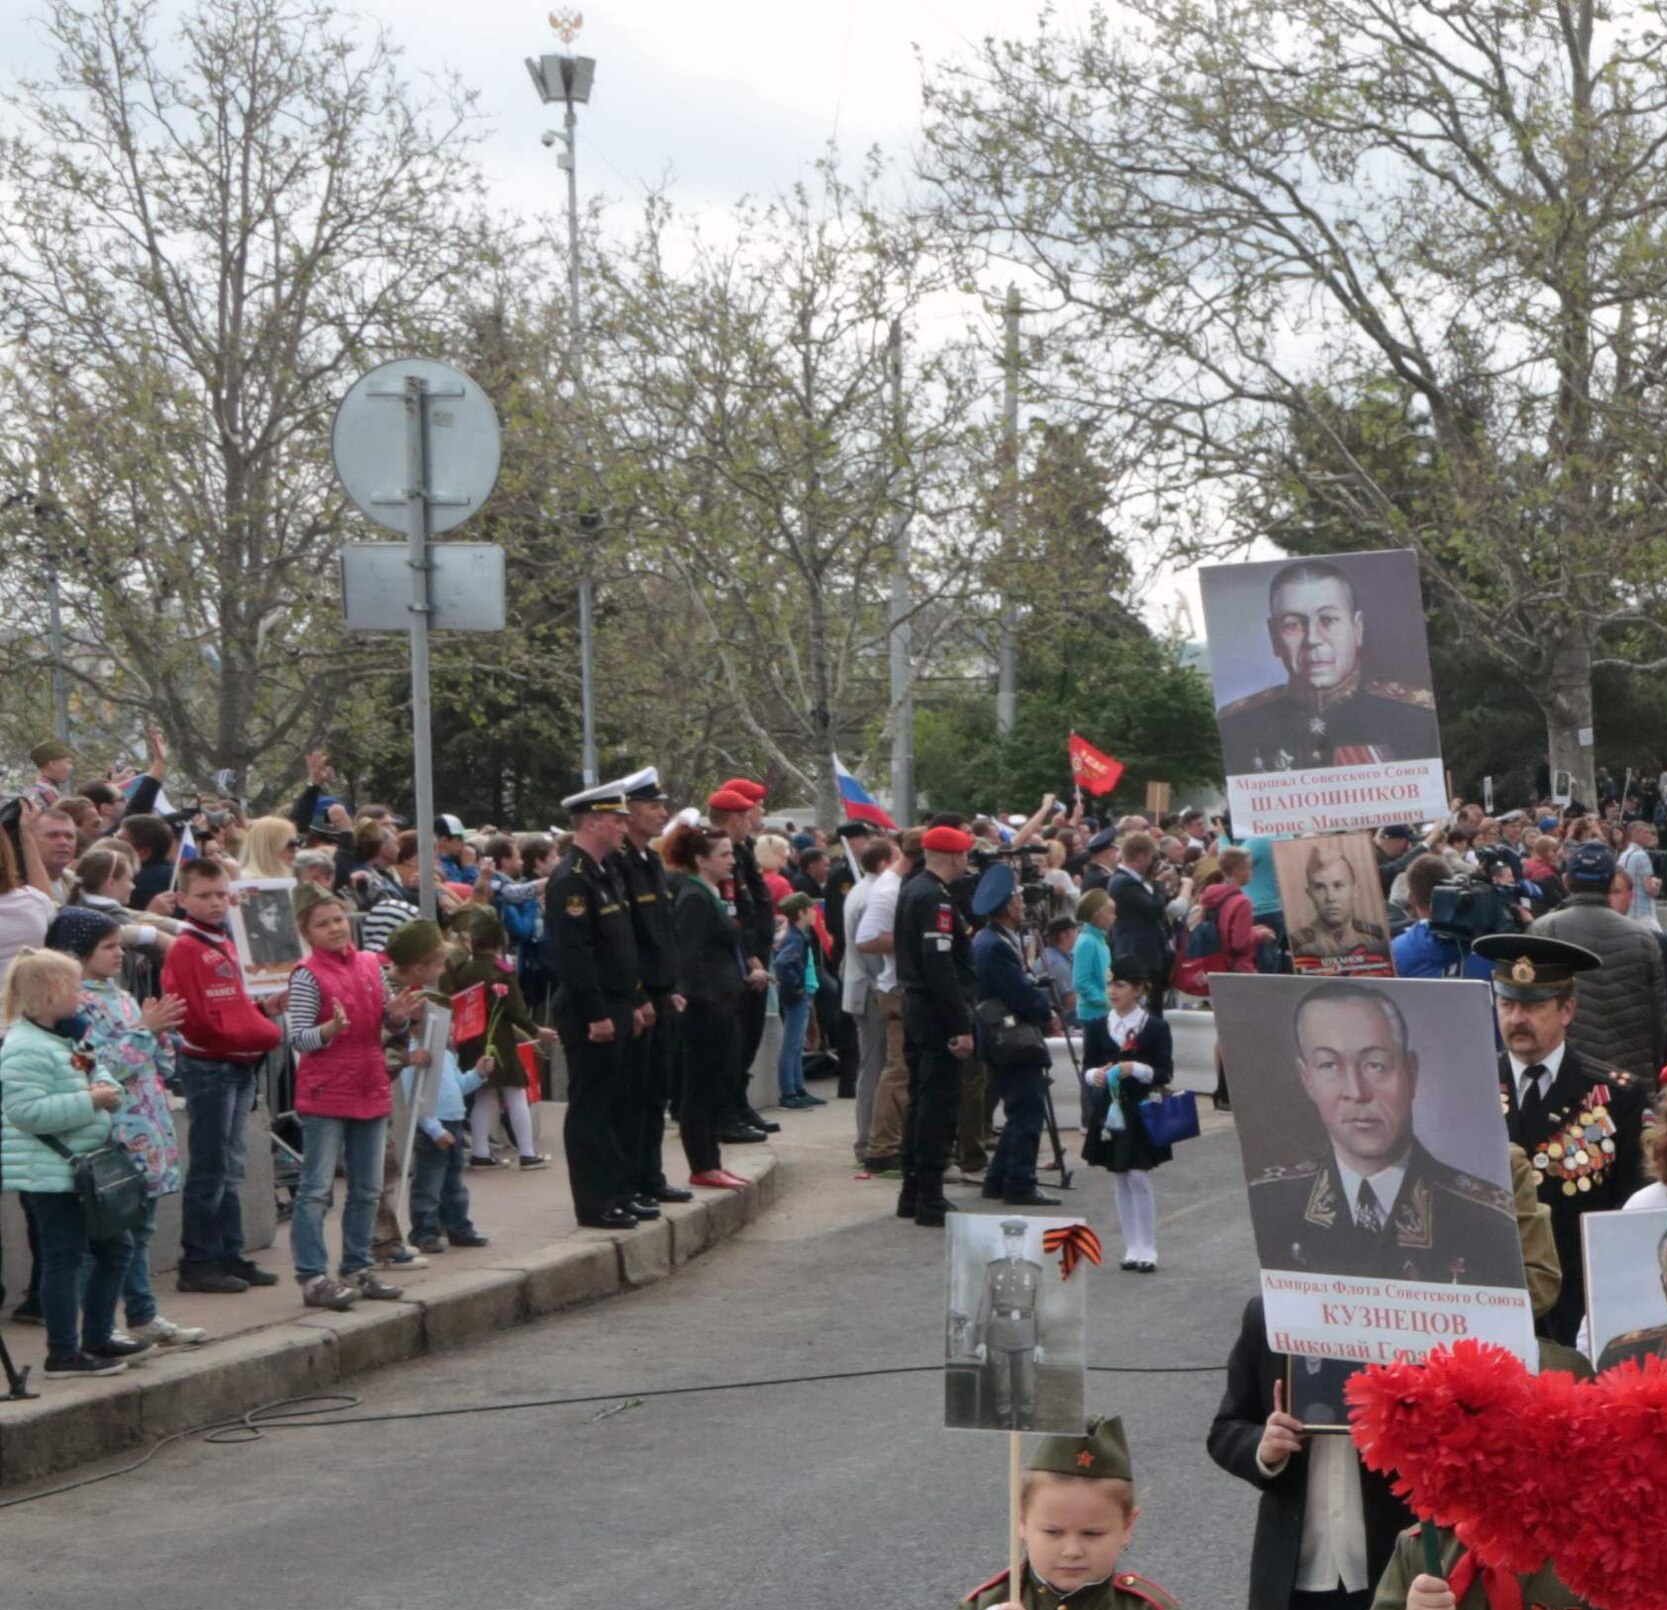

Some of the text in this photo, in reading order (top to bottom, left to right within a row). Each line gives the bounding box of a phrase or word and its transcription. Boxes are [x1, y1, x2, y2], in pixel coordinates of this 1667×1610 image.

[1237, 765, 1429, 793] Маршал Советского Союза
[1251, 783, 1420, 812] ШАПОШНИКОВ
[1252, 808, 1425, 836] Борис Михайлович
[1264, 1275, 1526, 1308] Адмирал Флота Советского Союза
[1322, 1303, 1468, 1336] КУЗНЕЦОВ
[1275, 1332, 1370, 1359] Николай
